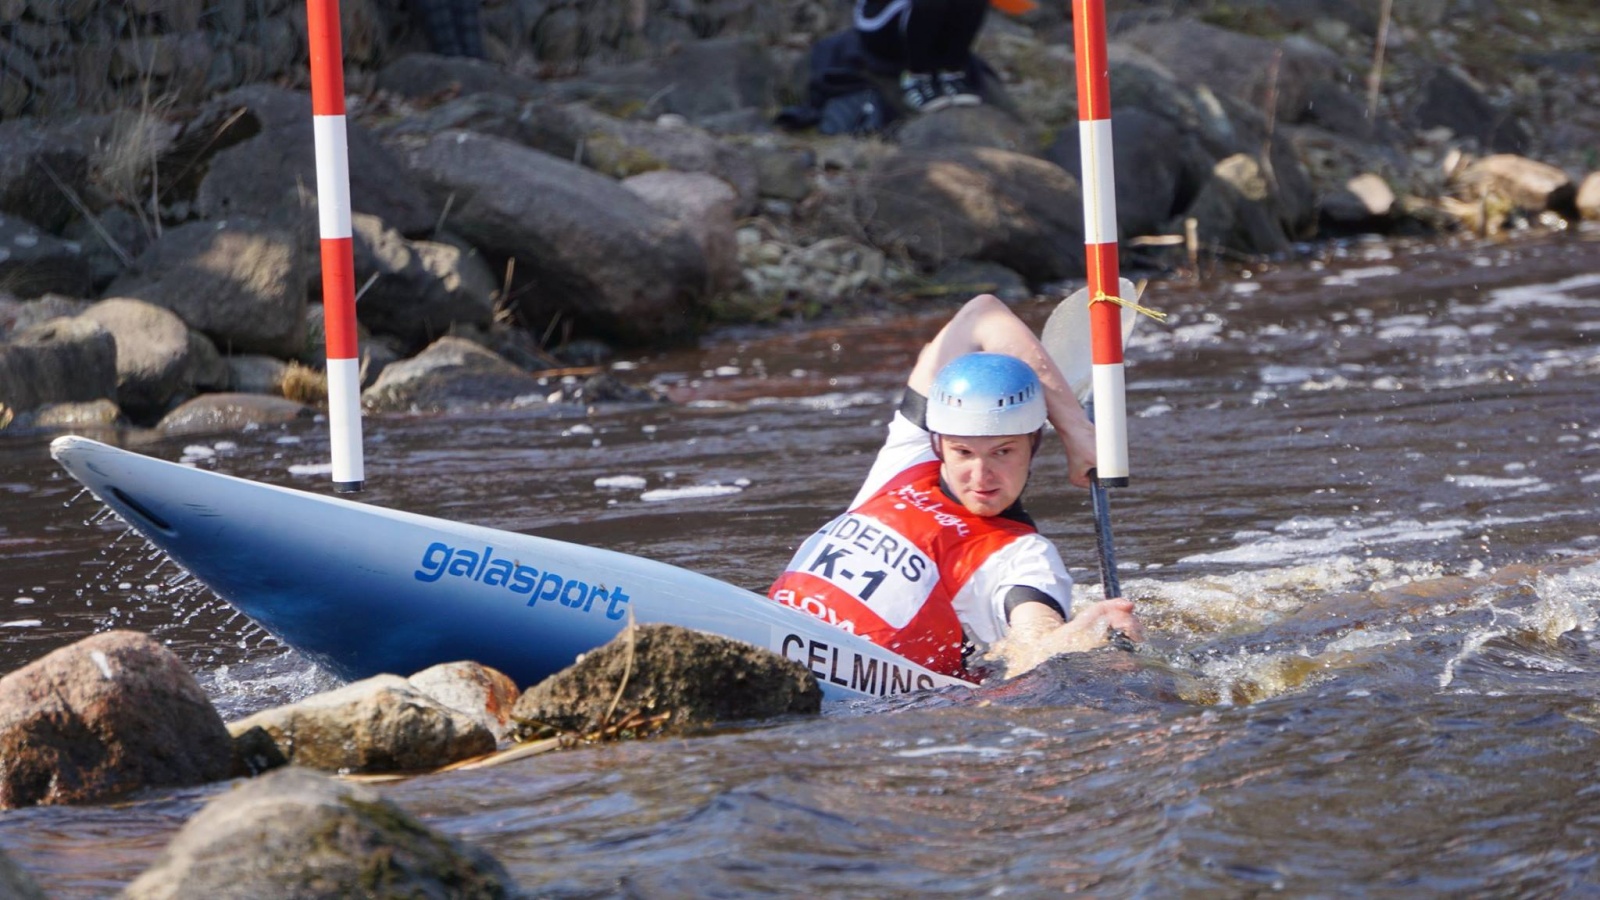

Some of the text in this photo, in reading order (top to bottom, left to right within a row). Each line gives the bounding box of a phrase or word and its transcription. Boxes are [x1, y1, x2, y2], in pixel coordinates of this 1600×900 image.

[414, 542, 630, 620] galasport
[808, 543, 888, 602] K-1
[818, 517, 926, 583] IDERIS
